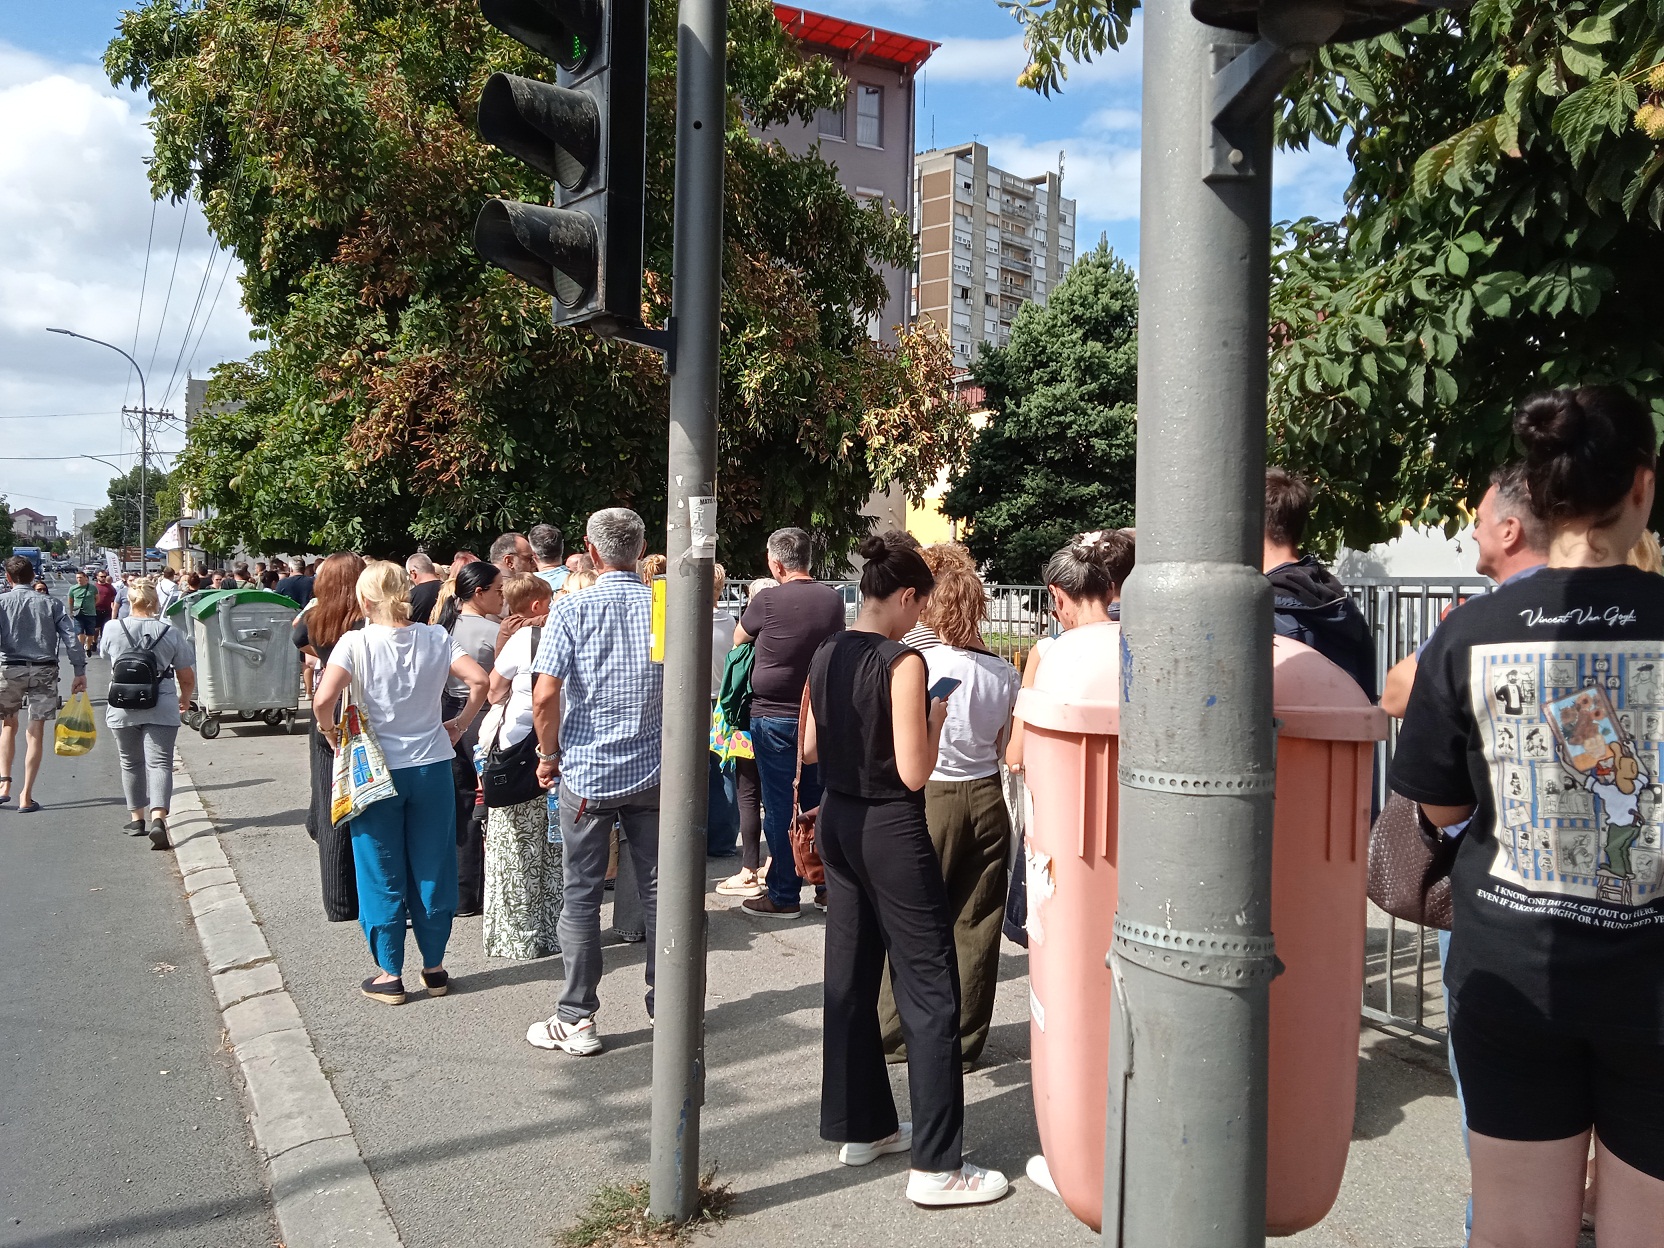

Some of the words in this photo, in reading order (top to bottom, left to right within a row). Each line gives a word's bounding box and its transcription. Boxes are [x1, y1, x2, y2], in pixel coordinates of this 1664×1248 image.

[1518, 607, 1572, 627] Vincent
[1570, 606, 1601, 624] Van
[1476, 889, 1500, 903] EVEN
[1499, 898, 1510, 906] IF
[1547, 908, 1579, 921] NIGHT
[1577, 914, 1592, 924] OR
[1593, 918, 1600, 926] A
[1494, 885, 1500, 893] I
[1500, 887, 1528, 902] KNOW
[1528, 898, 1547, 906] ONE
[1580, 905, 1598, 914] GET
[1598, 908, 1620, 919] OUT
